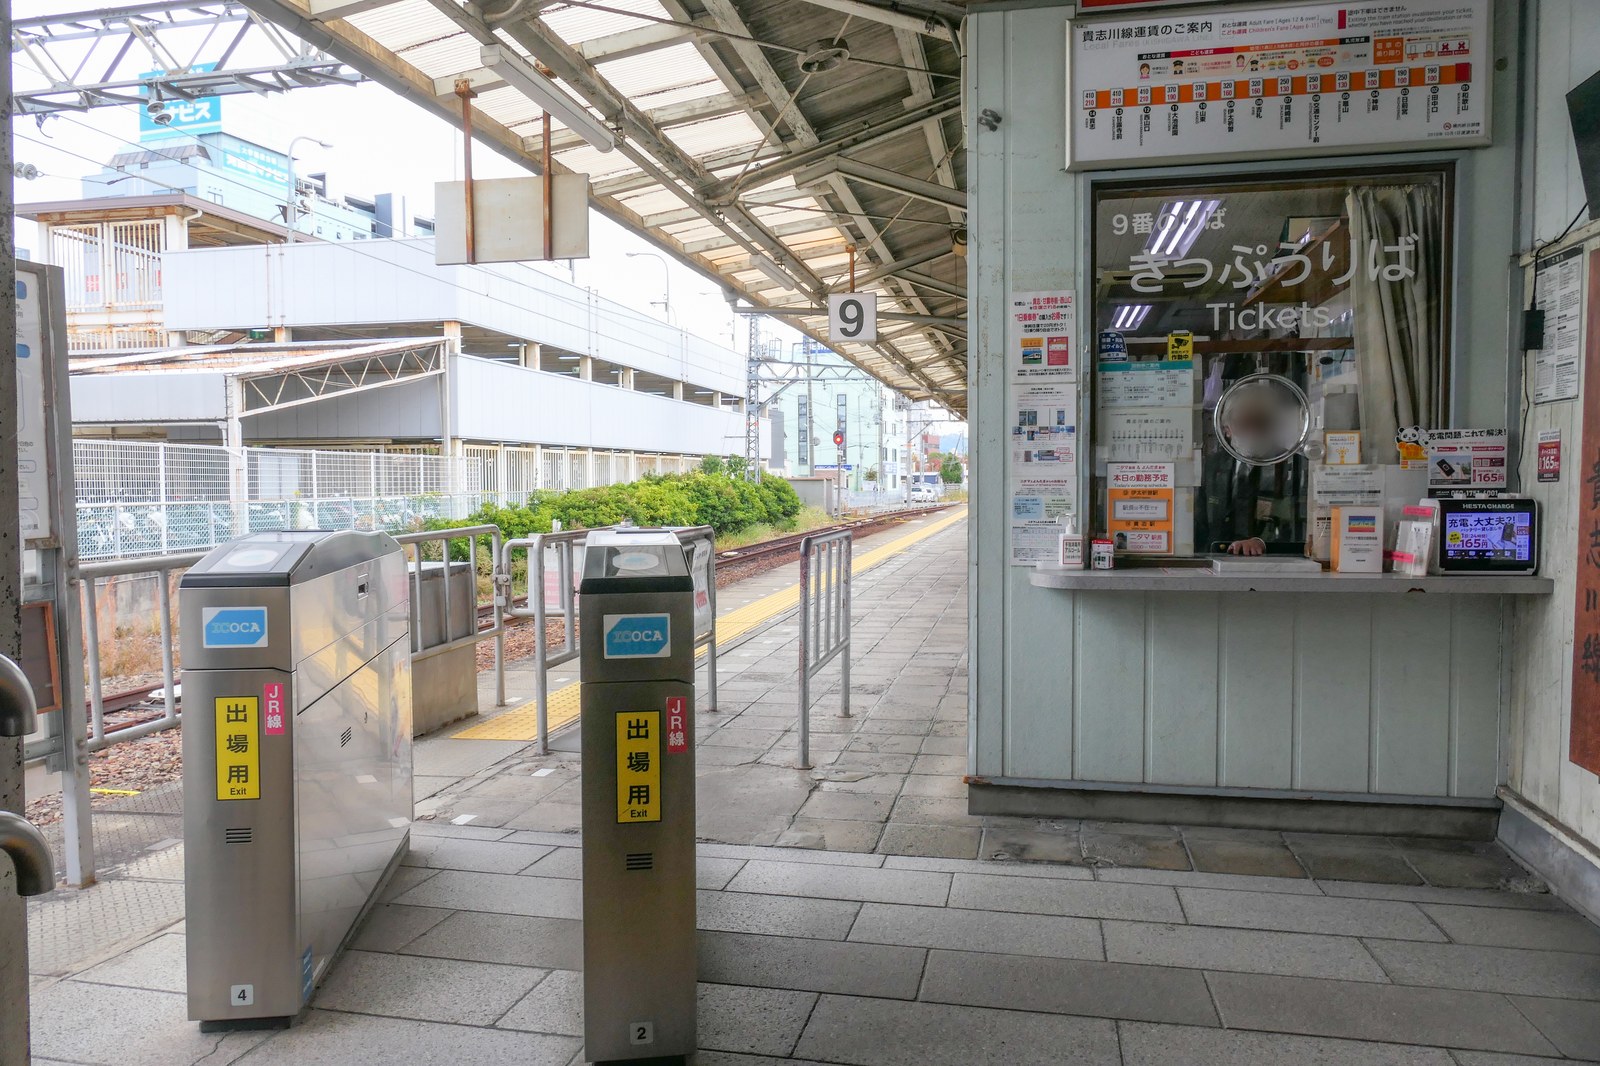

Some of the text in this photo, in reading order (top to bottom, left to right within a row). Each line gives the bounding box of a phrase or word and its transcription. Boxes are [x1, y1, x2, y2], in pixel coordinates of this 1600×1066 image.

[1082, 21, 1213, 42] 貴志川線運賃のご案内
[1112, 208, 1228, 235] 9番のりば
[839, 299, 864, 338] 9
[1206, 302, 1330, 331] Tickets
[1113, 474, 1168, 482] 本日の勤務予定
[211, 622, 261, 634] ICOCA
[613, 630, 663, 643] ICOCA
[267, 686, 282, 729] JR線
[670, 700, 684, 746] JR線
[226, 704, 249, 784] 出場用
[627, 718, 650, 805] 出場用
[230, 788, 247, 796] Exit
[630, 810, 647, 818] Exit
[238, 989, 247, 1001] 4
[637, 1027, 646, 1039] 2
